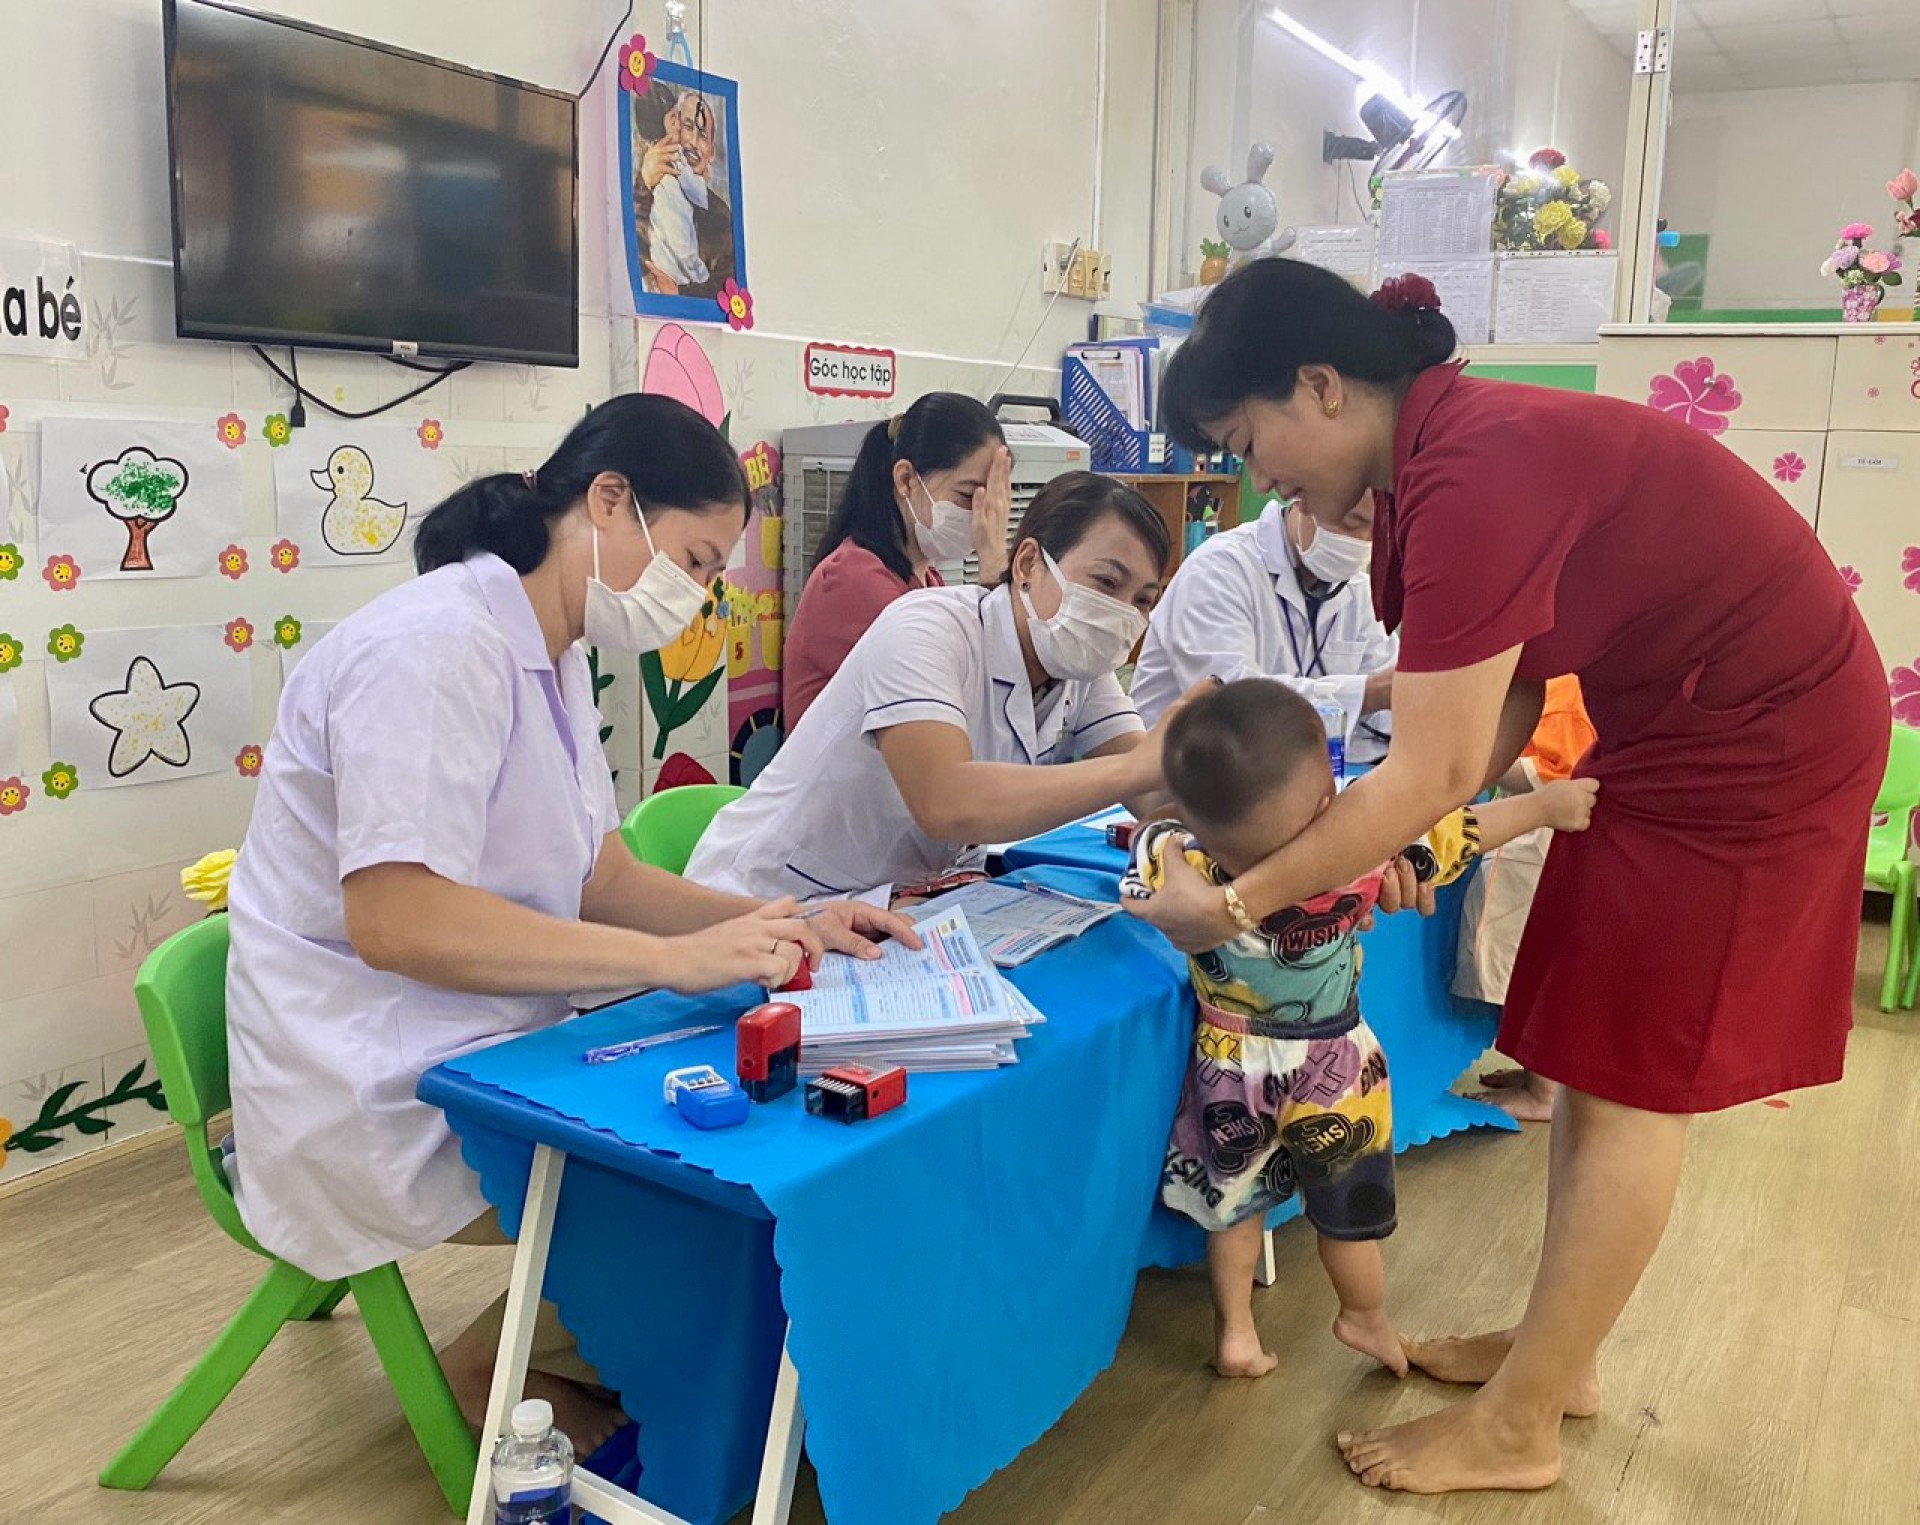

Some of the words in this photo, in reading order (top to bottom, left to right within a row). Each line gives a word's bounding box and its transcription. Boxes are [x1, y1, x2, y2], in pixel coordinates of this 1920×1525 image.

[0, 286, 28, 336] a
[36, 275, 81, 341] bé
[810, 357, 838, 378] Góc
[842, 361, 868, 384] học
[870, 363, 892, 387] tập
[744, 443, 772, 492] BÉ
[734, 640, 744, 661] 5
[1286, 925, 1340, 952] WISH
